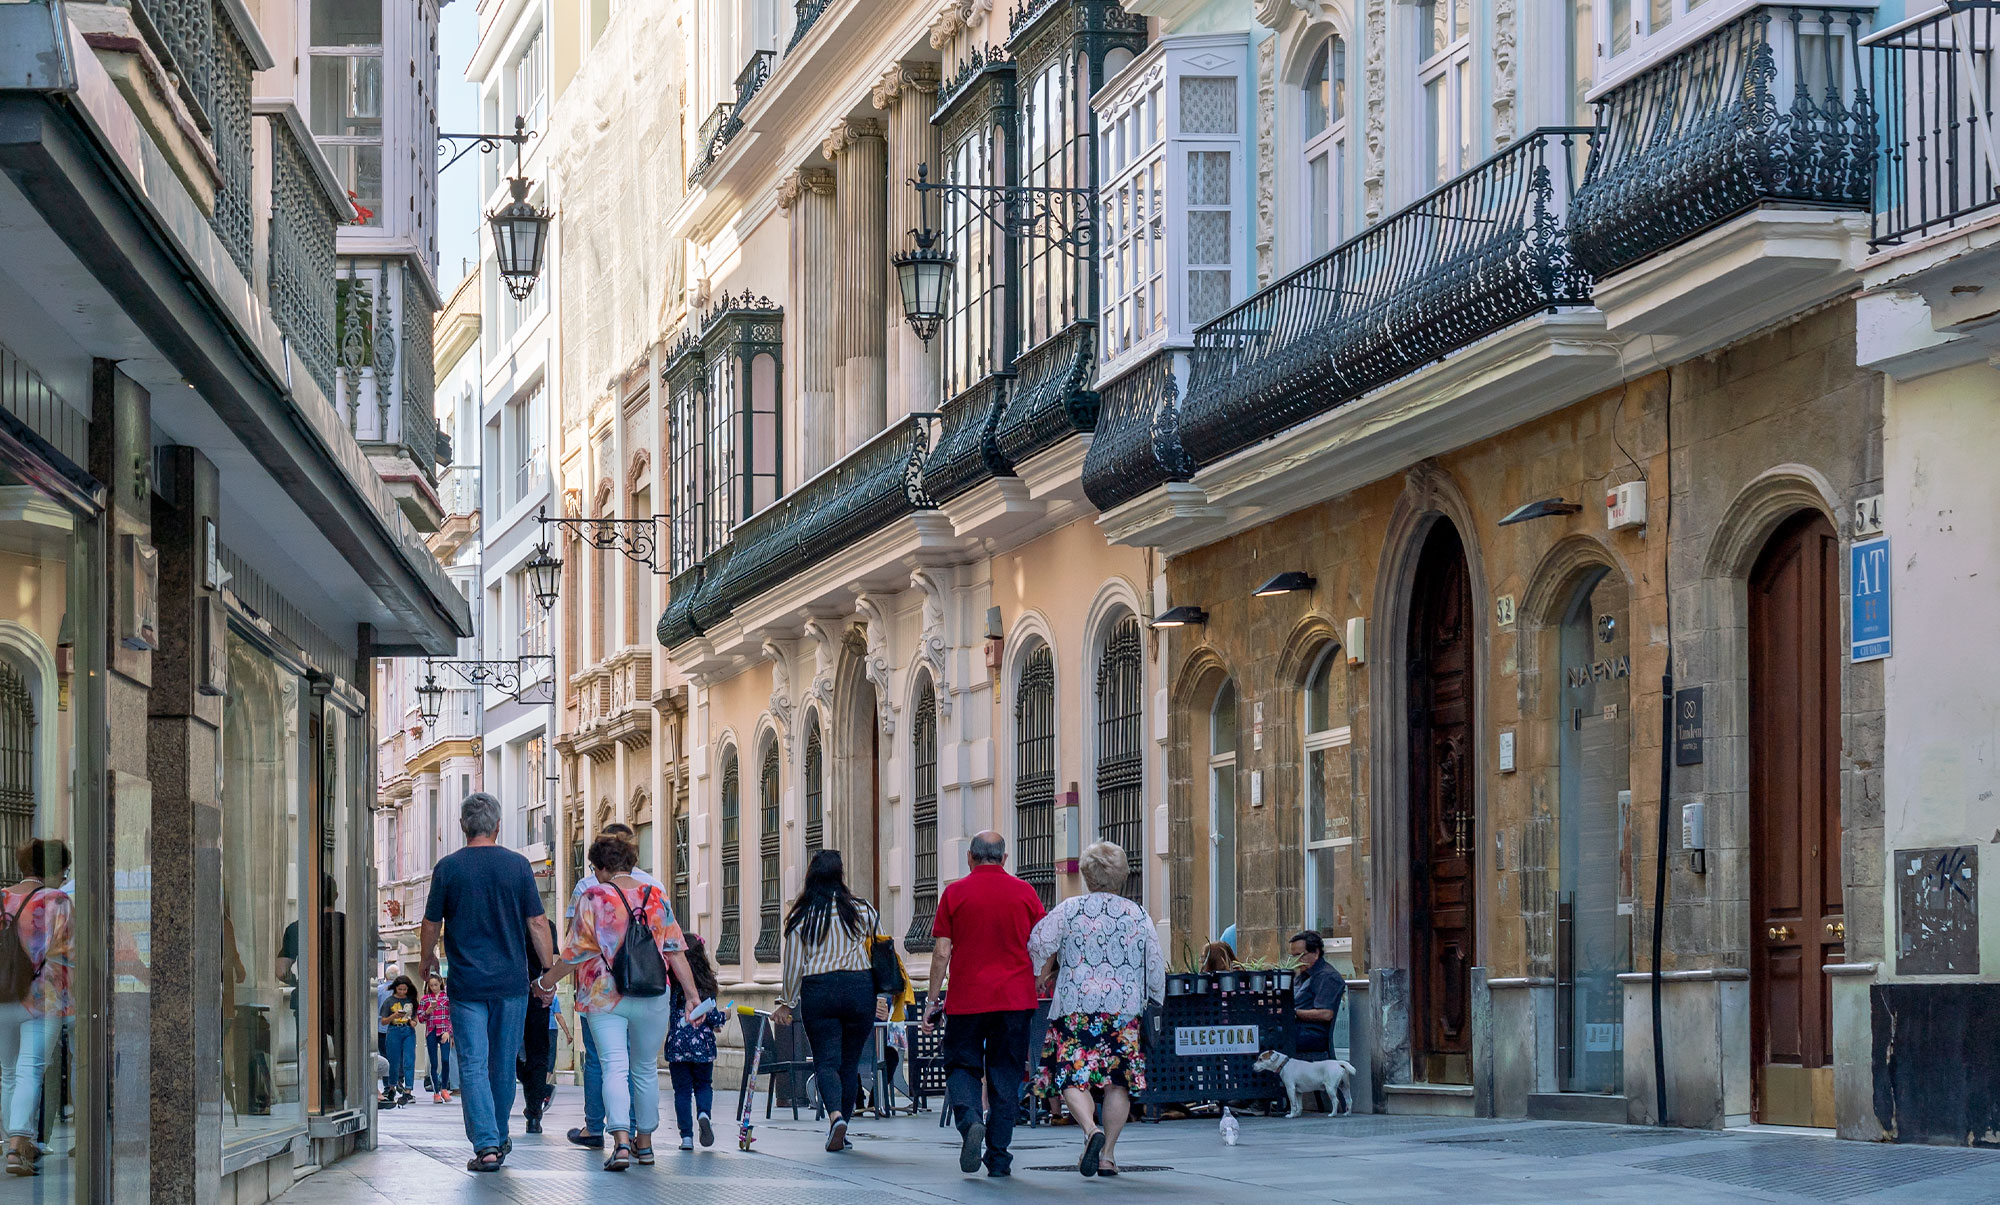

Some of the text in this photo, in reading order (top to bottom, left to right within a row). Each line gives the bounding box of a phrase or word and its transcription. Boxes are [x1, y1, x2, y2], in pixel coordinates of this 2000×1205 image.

[1856, 549, 1885, 597] AT
[1179, 1028, 1254, 1045] LA LECTORA
